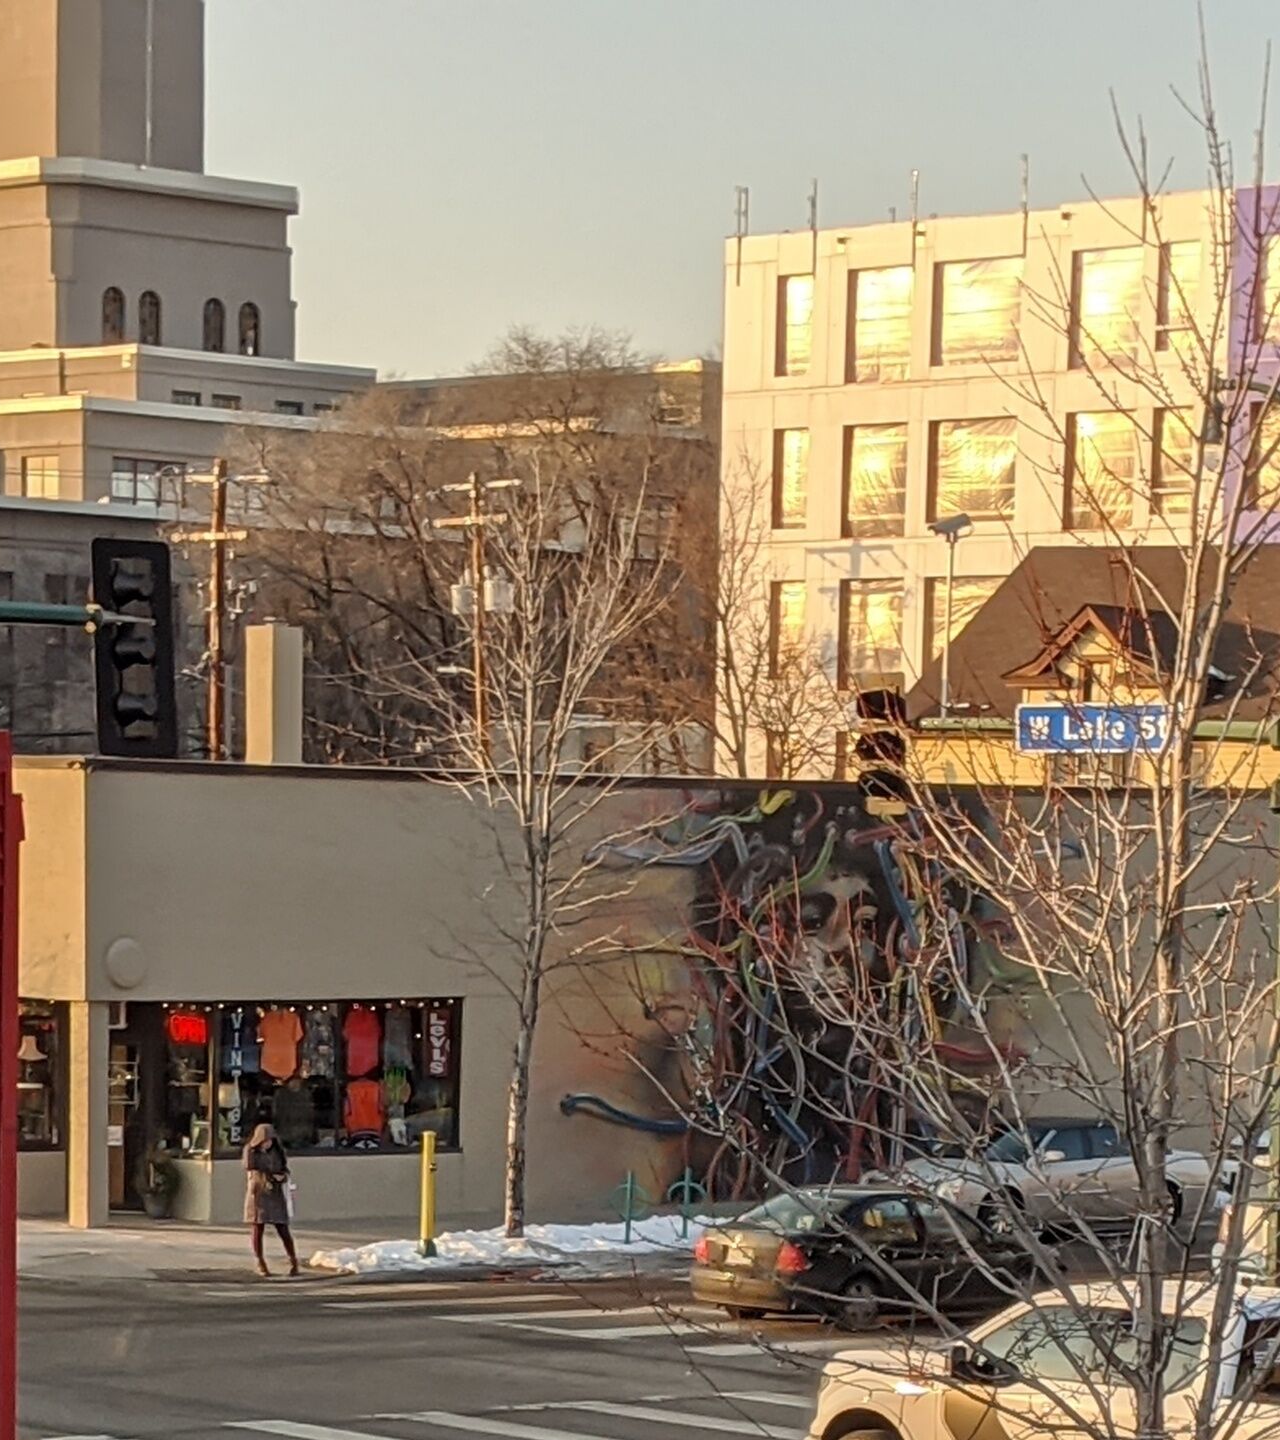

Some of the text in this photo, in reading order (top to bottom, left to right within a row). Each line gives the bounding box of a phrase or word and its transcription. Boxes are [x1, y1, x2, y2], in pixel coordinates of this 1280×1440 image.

[1028, 715, 1168, 740] W Lake St
